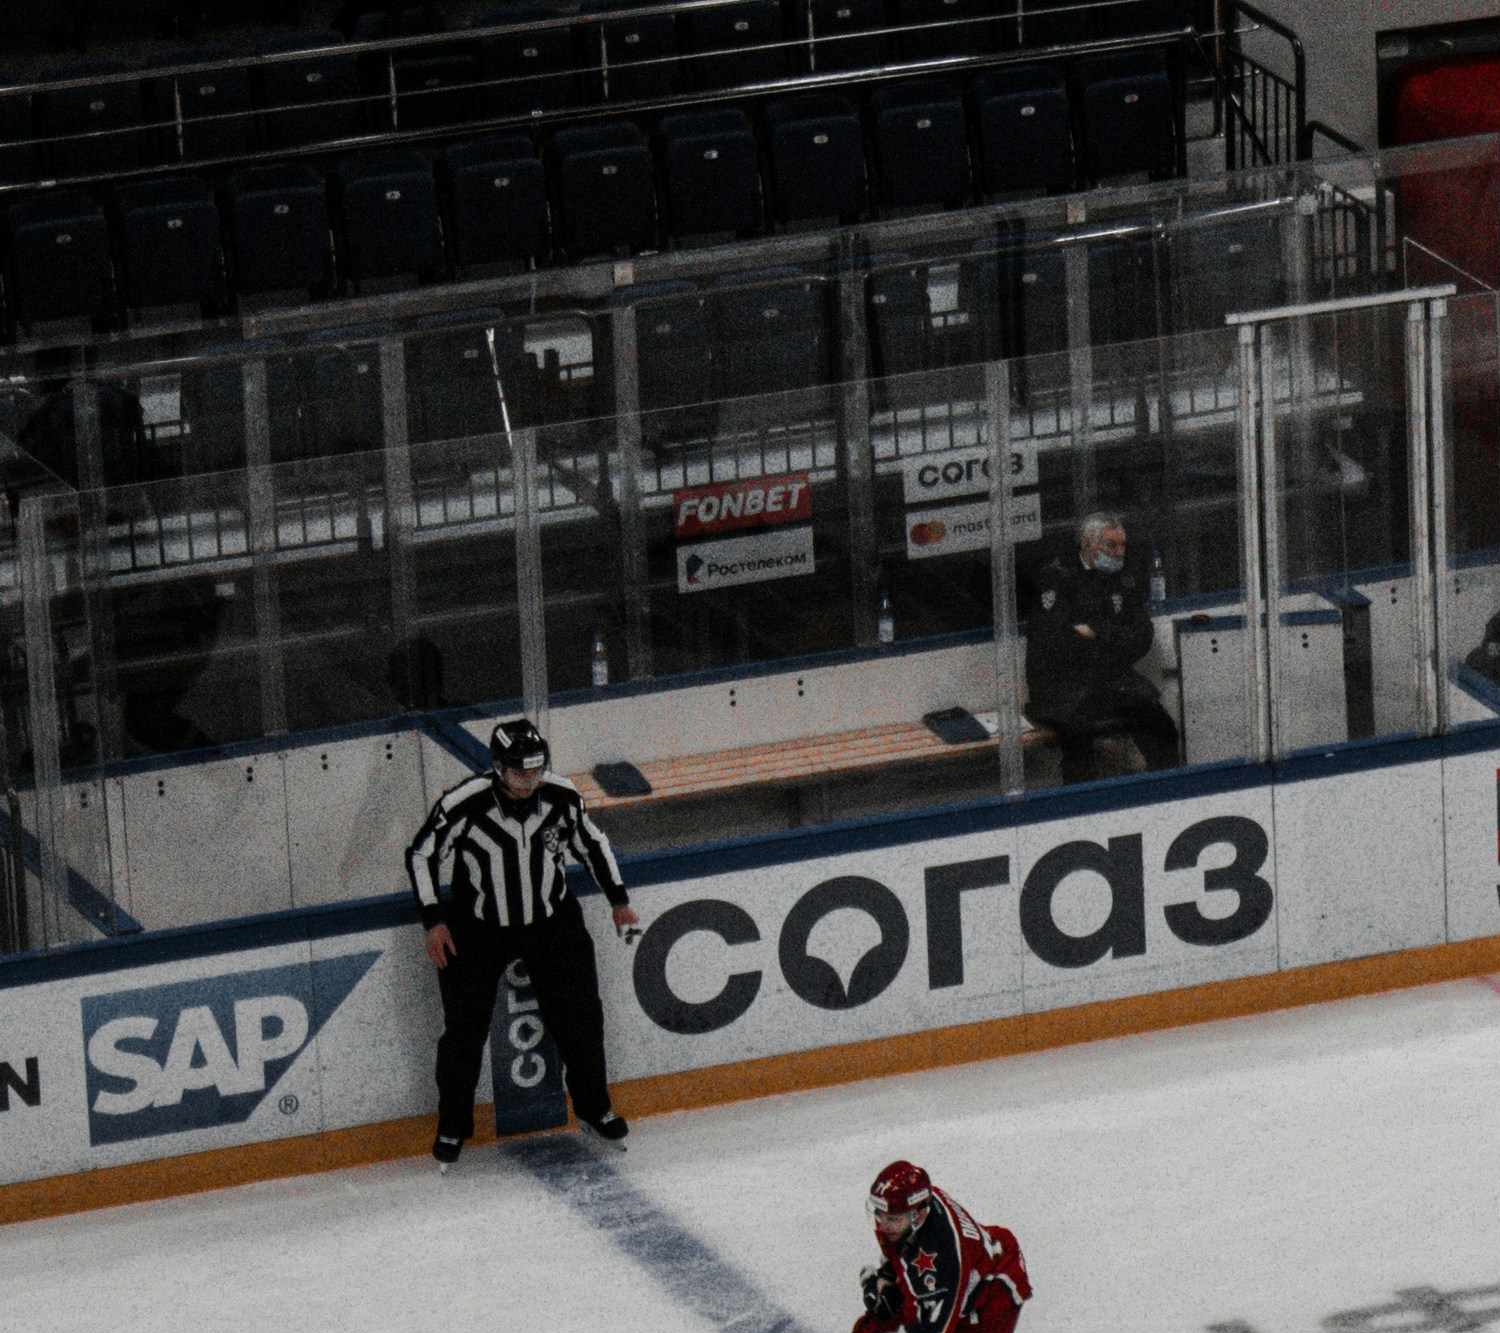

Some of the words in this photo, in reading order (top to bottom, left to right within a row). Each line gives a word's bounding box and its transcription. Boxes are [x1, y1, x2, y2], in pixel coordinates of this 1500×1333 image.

[677, 482, 808, 526] FONBET
[708, 553, 807, 577] Ростелеком
[88, 992, 309, 1117] SAP
